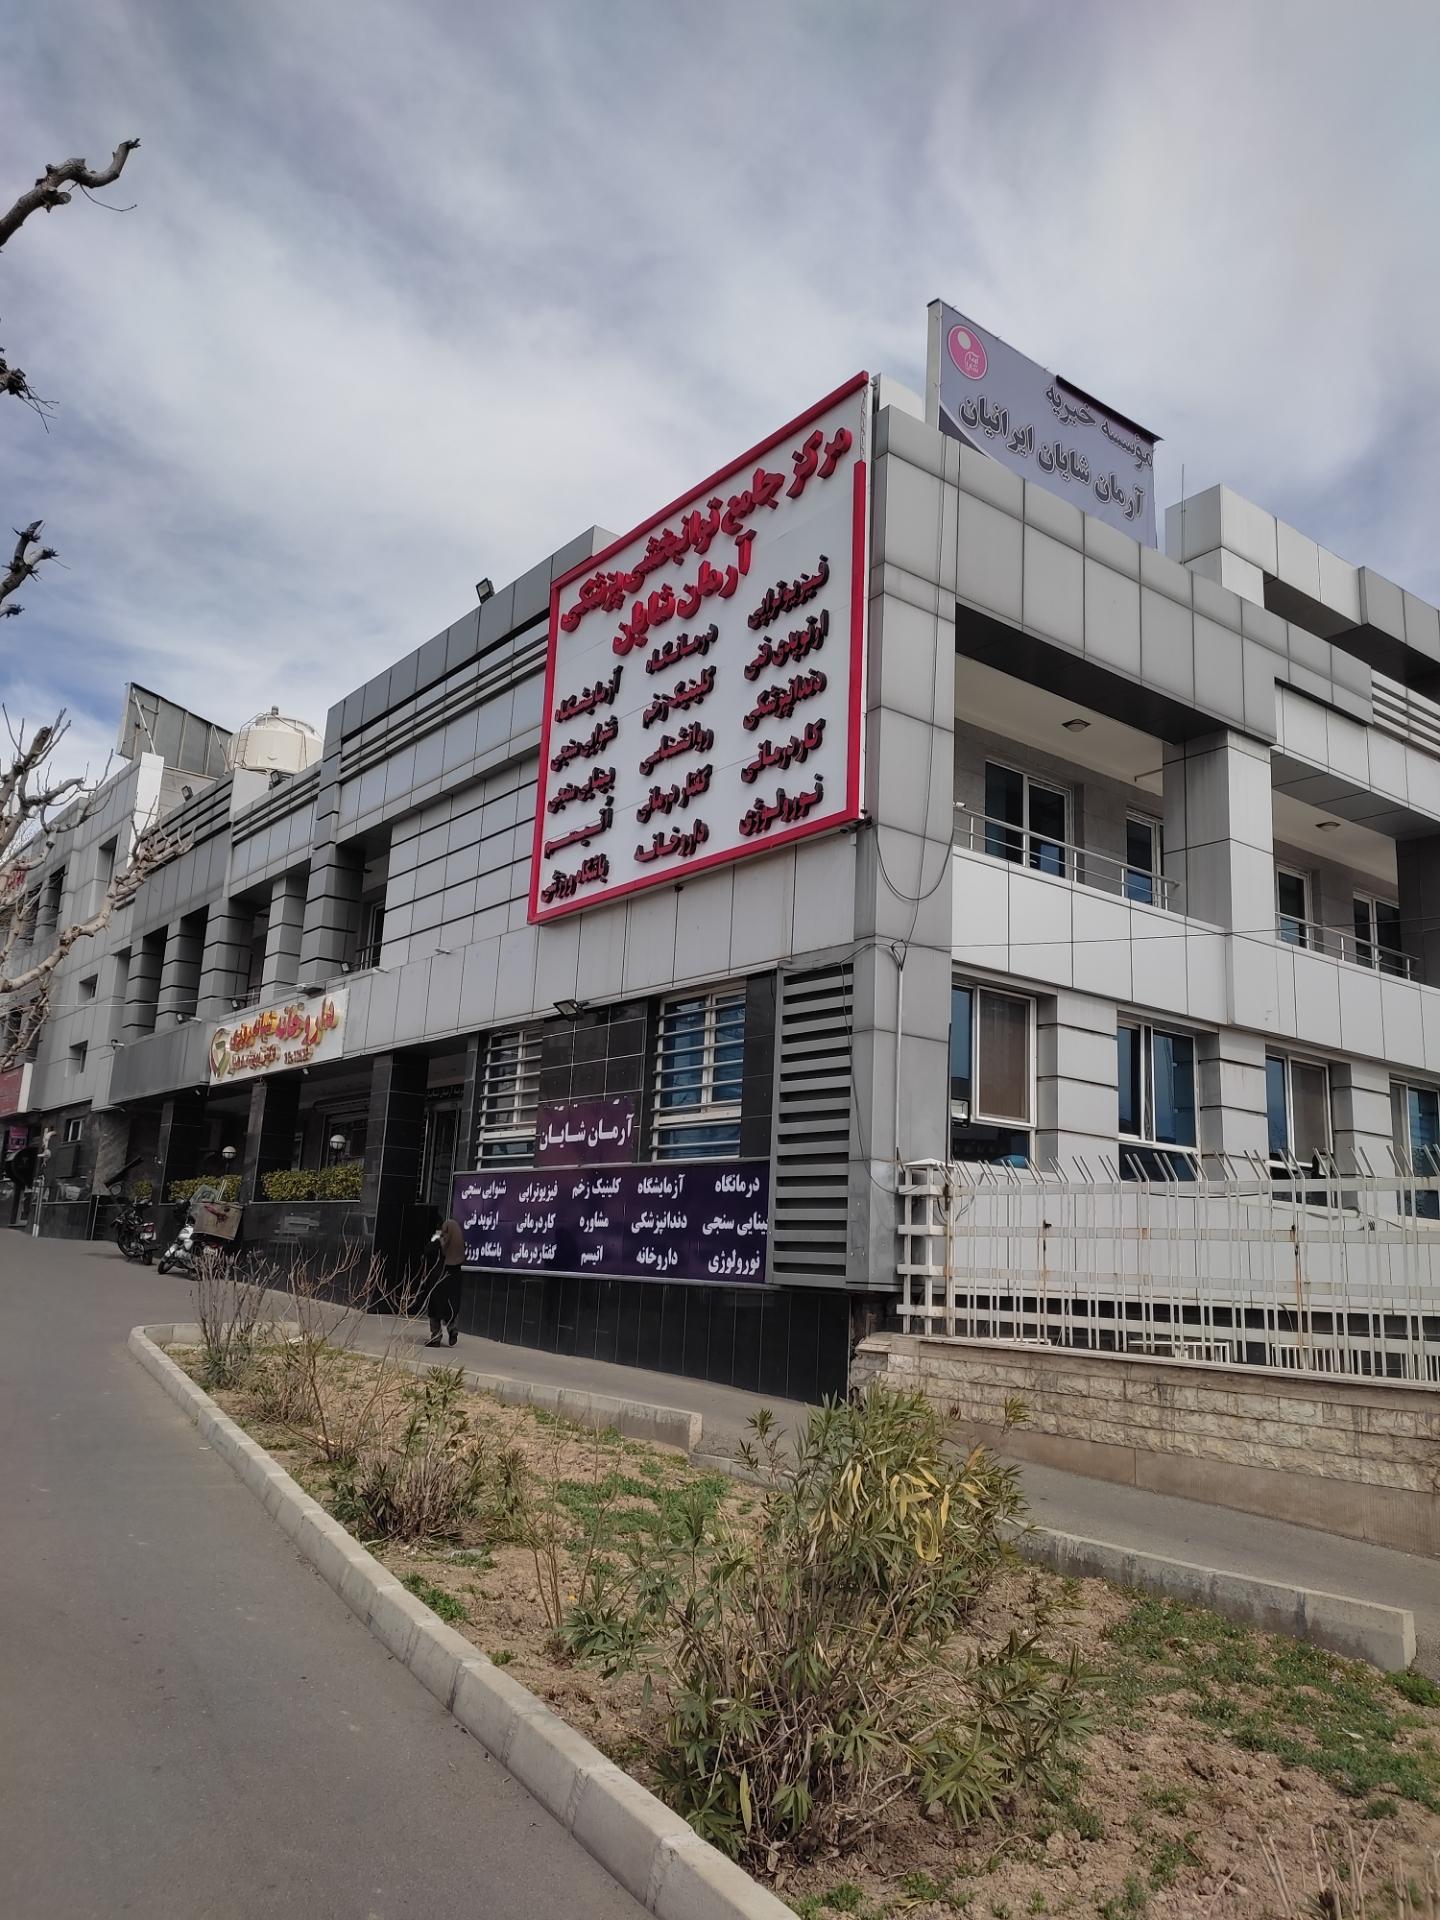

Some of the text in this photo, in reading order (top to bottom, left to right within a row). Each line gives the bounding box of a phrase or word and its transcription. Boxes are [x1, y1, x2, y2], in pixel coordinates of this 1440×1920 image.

[1046, 385, 1097, 426] خیریه
[958, 395, 1145, 521] آرمان شایان ایرانیان
[560, 427, 852, 633] مرکز جامع توانبخشی پزشکی
[612, 528, 758, 656] آرمان شایان
[748, 554, 830, 630] فیزیوتراپی
[645, 623, 719, 675] درمانگاه
[744, 635, 772, 681] فنی
[555, 664, 624, 723] آزمایشگاه
[642, 665, 717, 730] کلینیک زخم
[743, 668, 828, 731] دندانپزشکی
[550, 738, 582, 772] سنجی
[639, 721, 715, 777] روانشناسی
[547, 767, 616, 815] بینایی سنجی
[636, 763, 713, 824] گفتار درمانی
[738, 772, 825, 837] نورولوژی
[634, 818, 710, 863] داروخانه
[541, 853, 609, 903] باشگاه ورزشی
[539, 1113, 635, 1151] آرمان شایان
[461, 1179, 507, 1200] شنوایی سنجی
[518, 1180, 559, 1203] فیزیوتراپی
[571, 1176, 622, 1199] کلینیک زخم
[637, 1173, 686, 1199] آزمایشگاه
[715, 1173, 760, 1198] درمانگاه
[463, 1209, 499, 1231] ارتوپد فنی
[579, 1210, 610, 1233] مشاوره
[630, 1210, 688, 1235] دندانپزشکی
[702, 1213, 735, 1235] سنجی
[480, 1241, 502, 1262] باشگاه
[580, 1244, 604, 1265] اتیسم
[636, 1246, 679, 1271] داروخانه
[707, 1249, 761, 1275] نورولوژی
